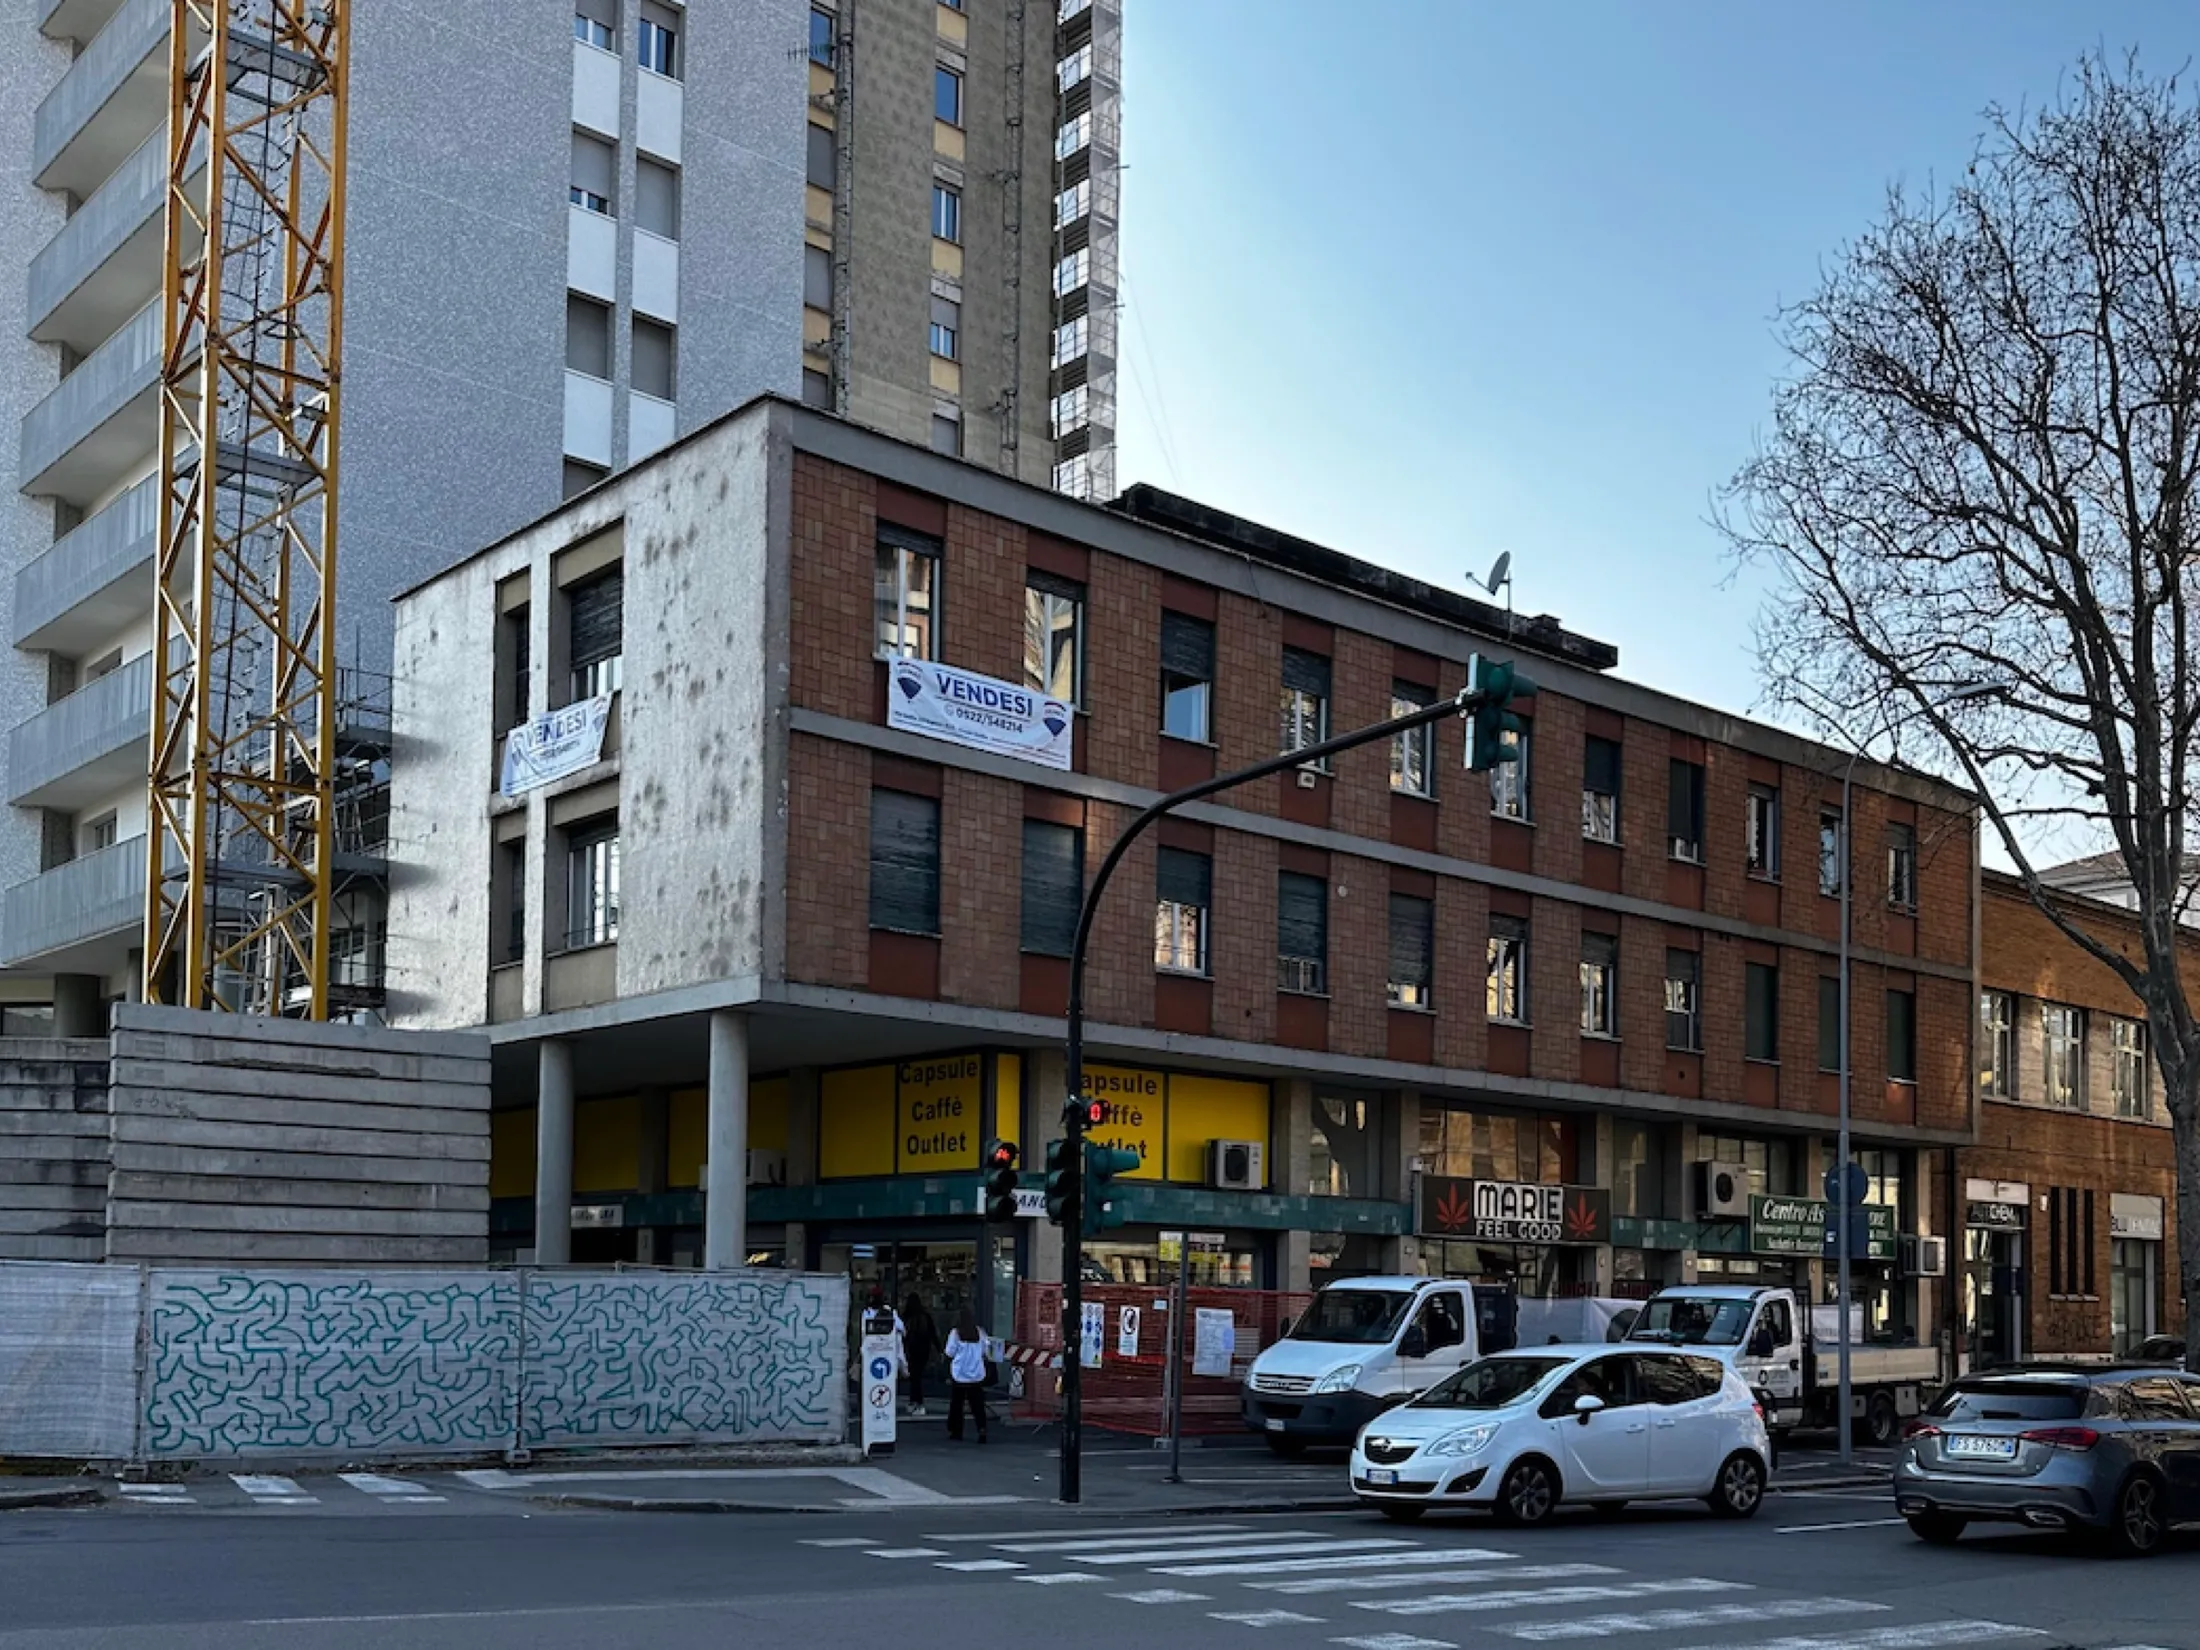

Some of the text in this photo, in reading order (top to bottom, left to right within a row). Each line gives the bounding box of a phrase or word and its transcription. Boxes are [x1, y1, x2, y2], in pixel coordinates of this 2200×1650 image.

[936, 673, 1033, 717] VENDESI
[955, 707, 1024, 734] 0522/548214
[900, 1058, 978, 1088] Capsule
[1081, 1073, 1157, 1096] apsule
[911, 1096, 963, 1122] Caffè
[907, 1131, 967, 1155] Outlet
[1477, 1183, 1561, 1221] MARIE
[1761, 1199, 1808, 1222] Centro
[1476, 1220, 1563, 1240] FEEL GOOD
